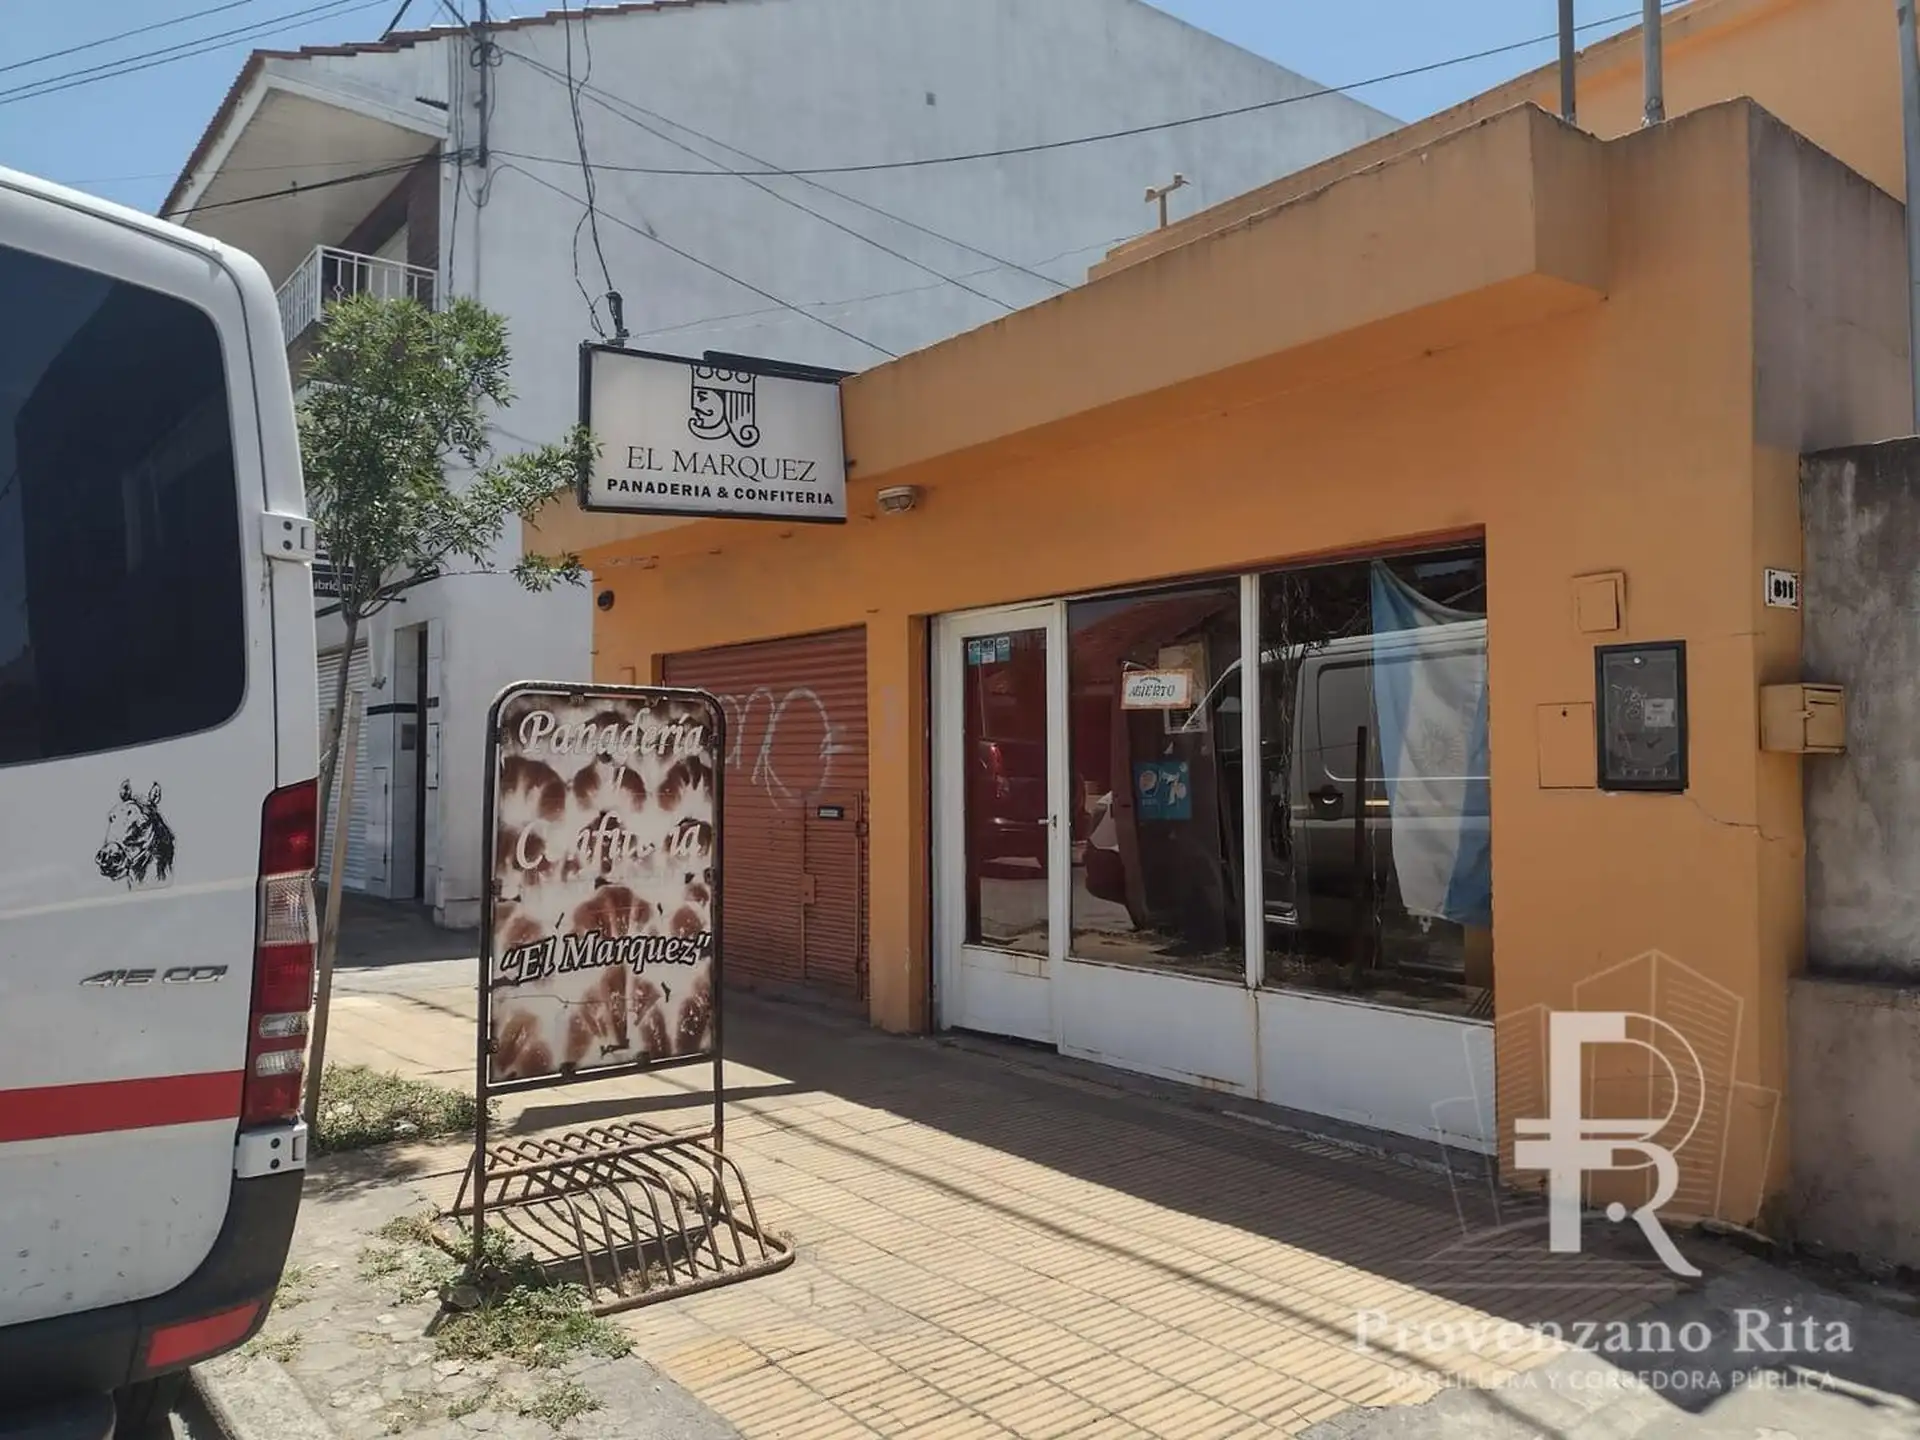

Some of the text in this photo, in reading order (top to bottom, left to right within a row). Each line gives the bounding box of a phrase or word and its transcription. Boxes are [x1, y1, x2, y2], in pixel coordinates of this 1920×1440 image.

[627, 445, 817, 483] EL MARQUEZ
[606, 478, 834, 505] PANADERIA & CONFITERIA
[518, 708, 704, 757] Panadería
[79, 963, 229, 988] 415 CDI
